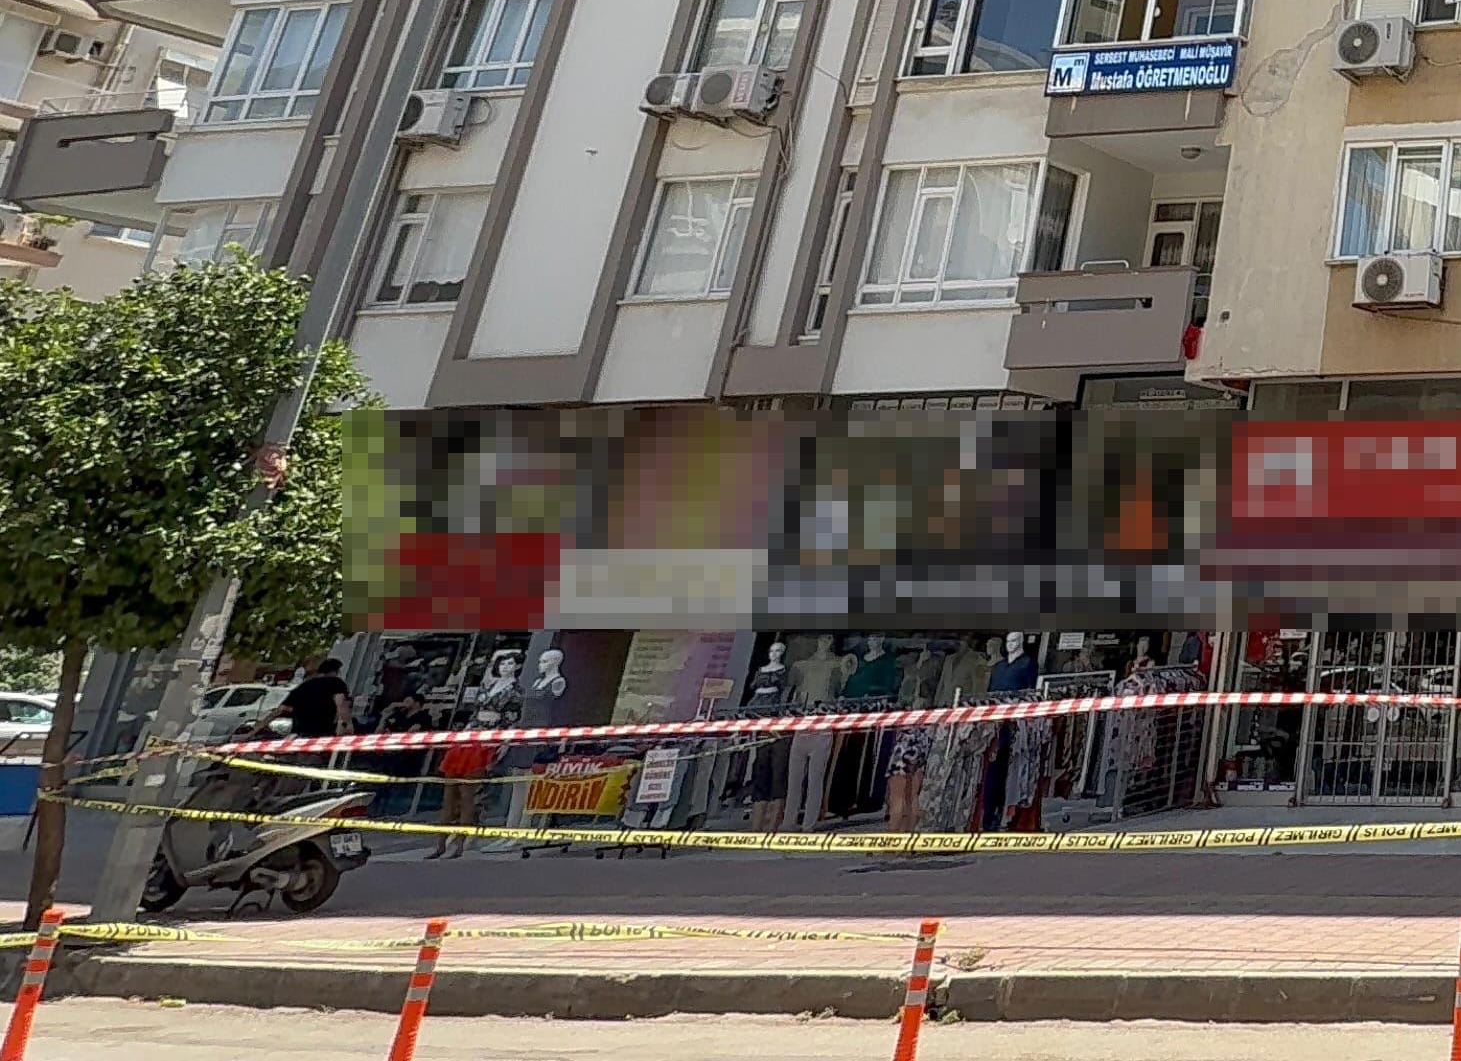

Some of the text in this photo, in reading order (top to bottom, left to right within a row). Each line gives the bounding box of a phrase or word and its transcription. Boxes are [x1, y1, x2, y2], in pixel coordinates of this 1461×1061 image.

[1094, 43, 1233, 65] SERBEST MUHASEBECİ MALİ MÜŞAVİR
[1090, 61, 1230, 91] Mustafa ÖĞRETMENOĞLU
